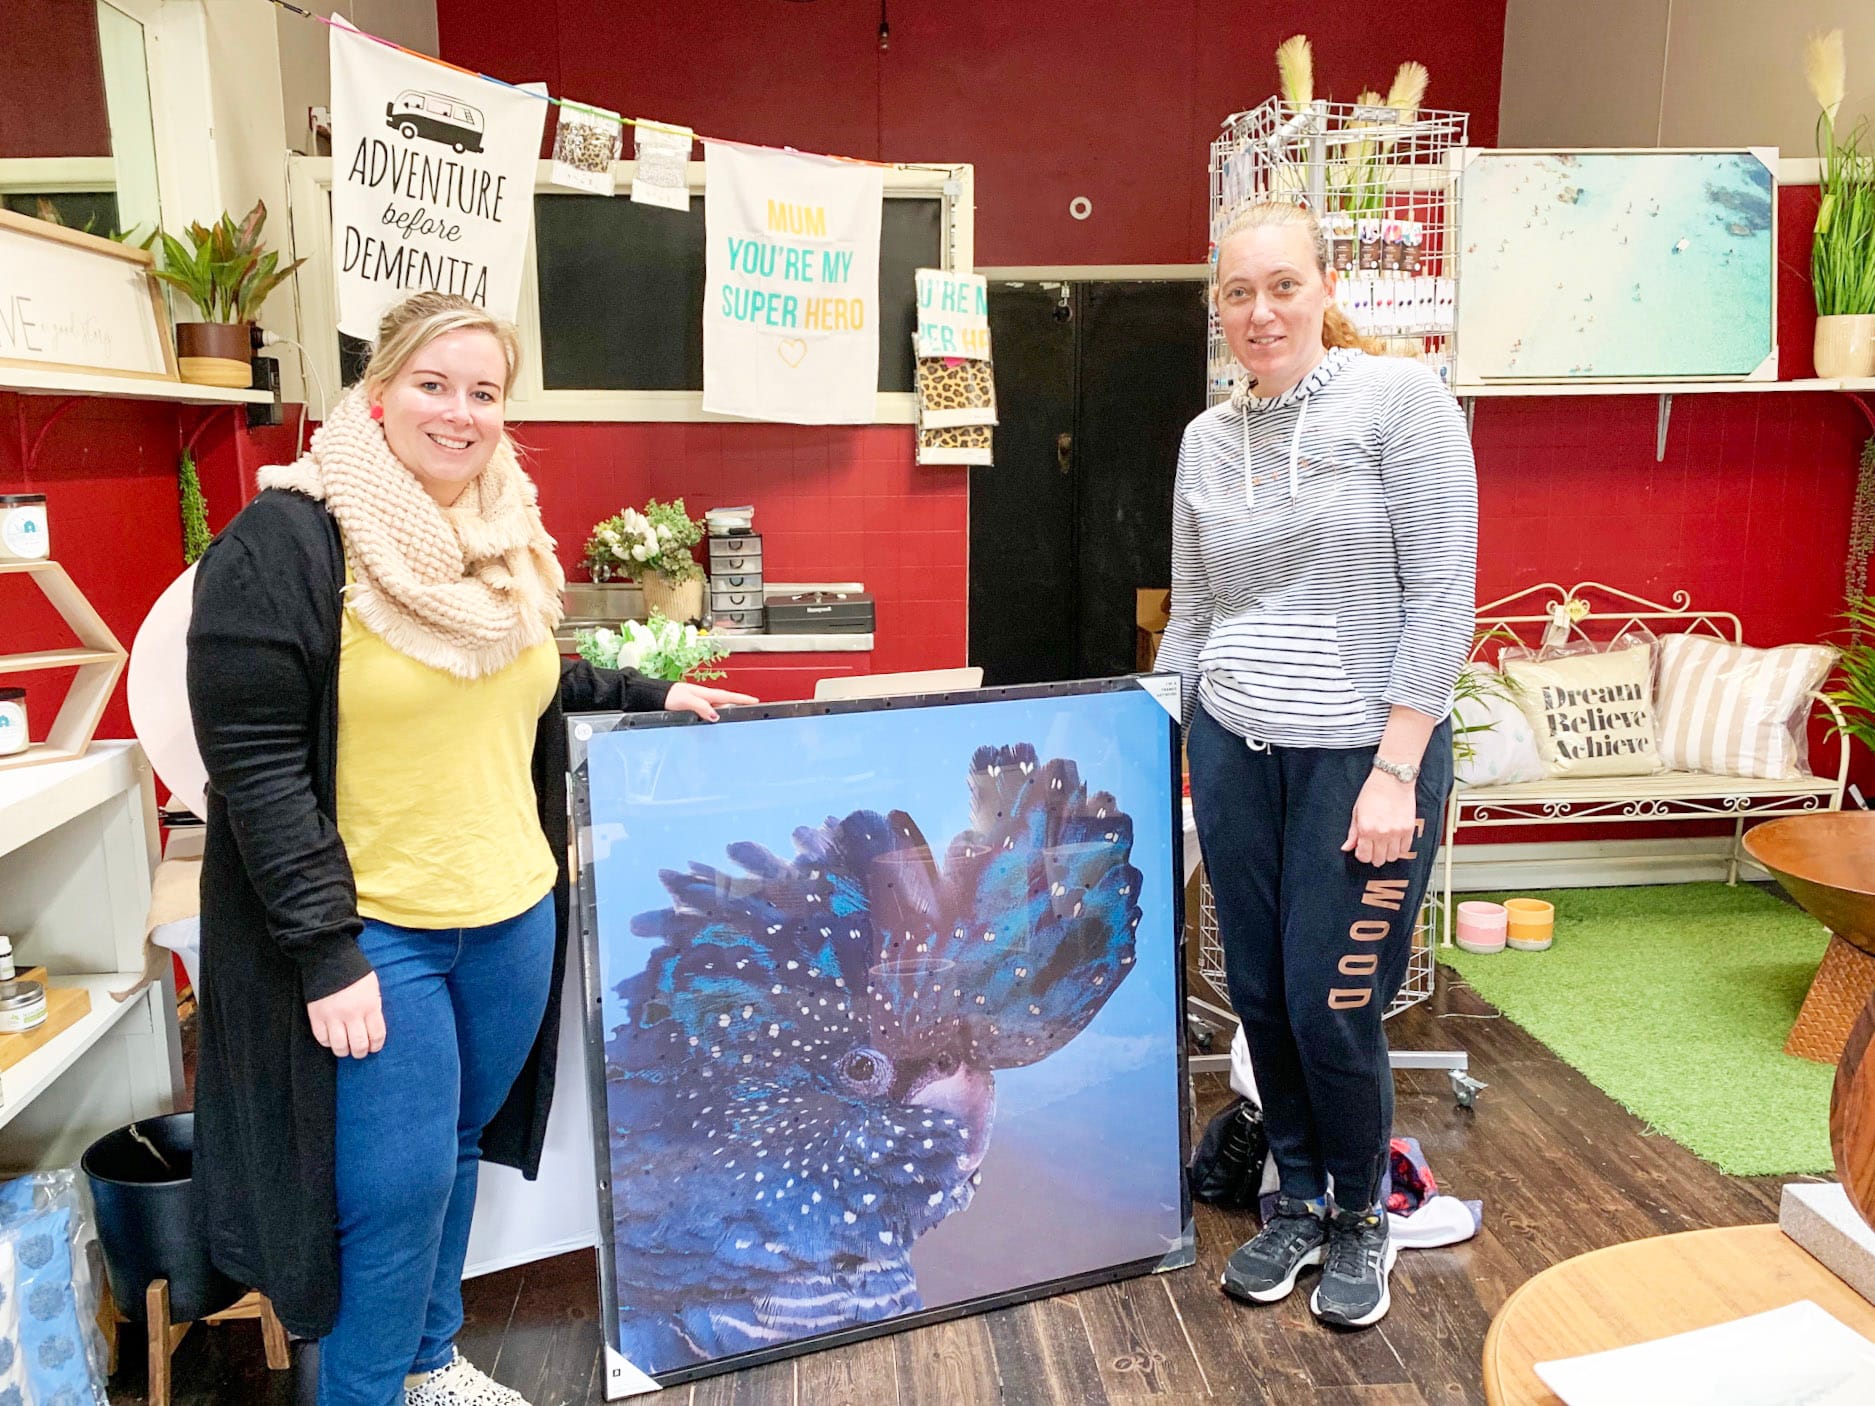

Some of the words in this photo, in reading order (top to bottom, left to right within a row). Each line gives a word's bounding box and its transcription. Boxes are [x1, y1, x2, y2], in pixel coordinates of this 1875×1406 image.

[348, 136, 507, 223] ADVENTURE
[381, 202, 463, 242] before
[767, 198, 827, 237] MUM
[727, 236, 815, 283] YOU'RE
[821, 250, 854, 284] MY
[721, 283, 799, 329] SUPER
[804, 297, 865, 331] HERO
[1540, 683, 1643, 711] Dream
[1546, 707, 1647, 737] Believe
[1553, 734, 1649, 763] Achieve
